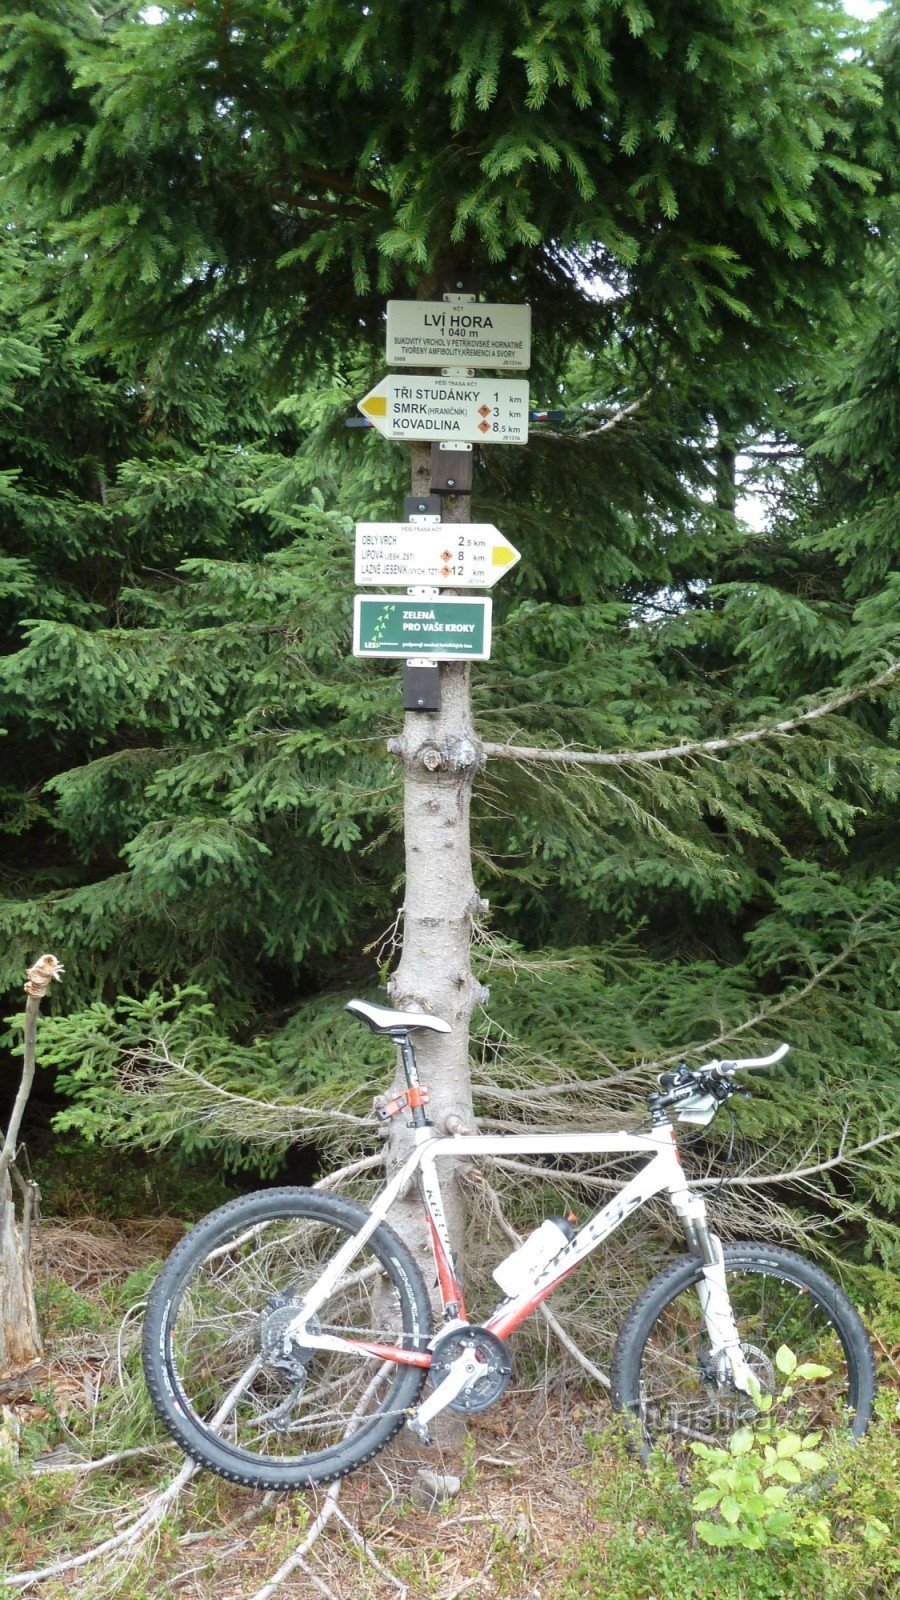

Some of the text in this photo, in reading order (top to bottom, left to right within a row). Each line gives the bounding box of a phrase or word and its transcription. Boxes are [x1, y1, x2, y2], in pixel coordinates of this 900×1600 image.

[424, 312, 494, 328] LVÍ HORA
[448, 328, 466, 337] 040
[402, 346, 428, 354] TVOŘENÝ
[496, 350, 516, 358] SVORY
[394, 386, 522, 404] TŘI STUDÁNKY 1 km
[394, 402, 428, 414] SMRK
[493, 408, 500, 418] 3
[393, 418, 460, 430] KOVADLINA
[508, 426, 520, 434] km
[380, 536, 396, 546] VRCH
[458, 551, 464, 561] 8
[452, 566, 464, 576] 12
[403, 610, 435, 620] ZELENÁ
[403, 622, 476, 632] PRO VAŠE KROKY
